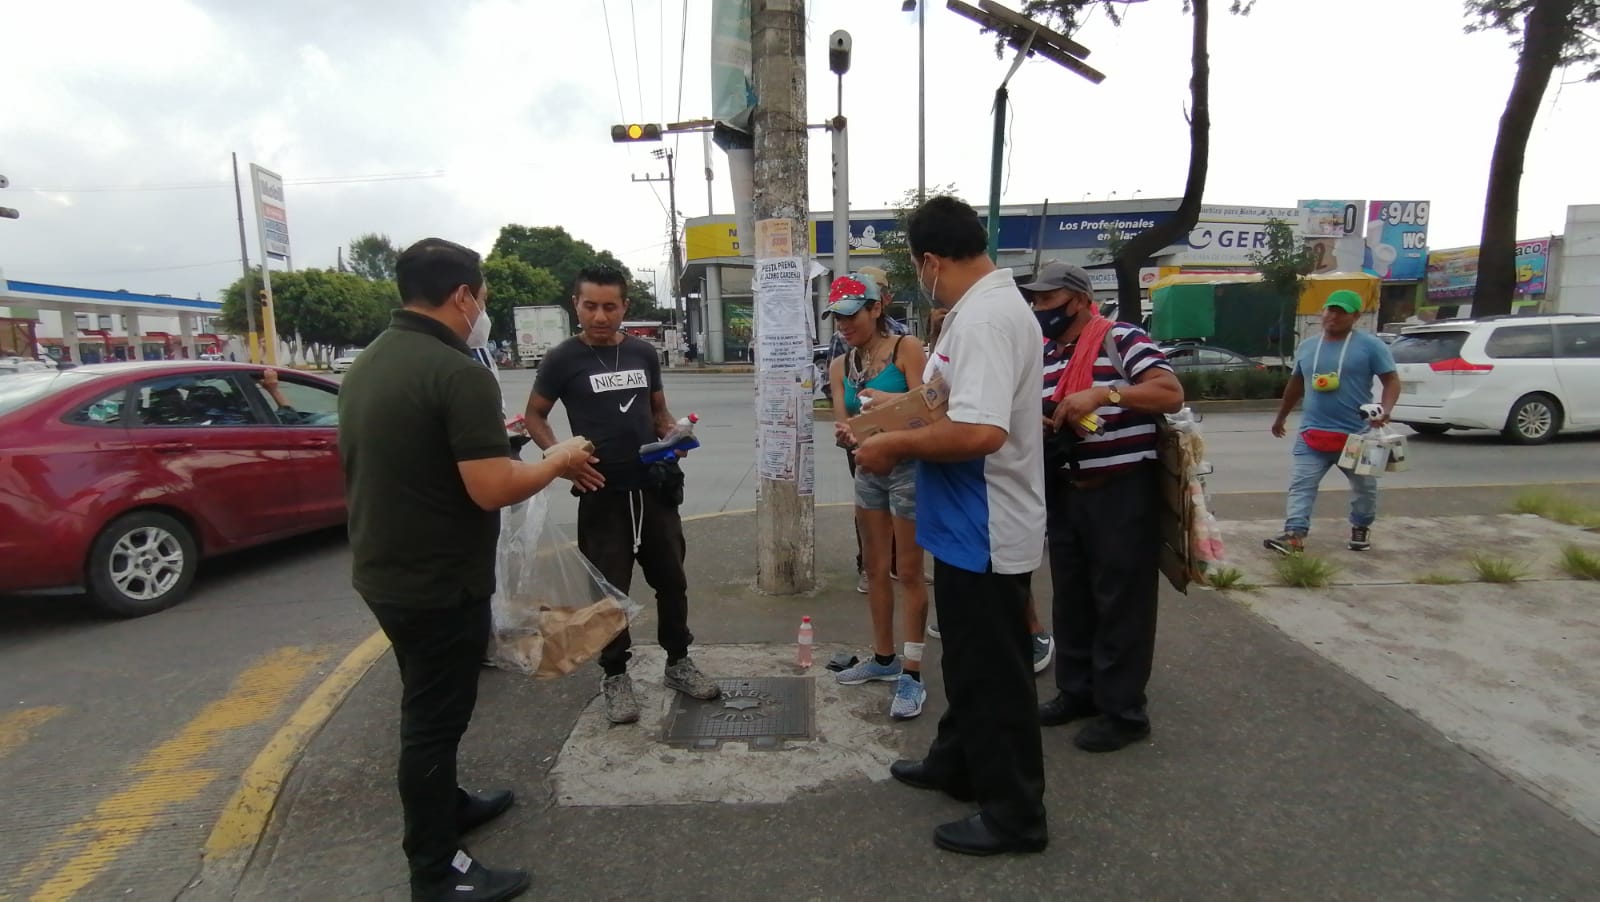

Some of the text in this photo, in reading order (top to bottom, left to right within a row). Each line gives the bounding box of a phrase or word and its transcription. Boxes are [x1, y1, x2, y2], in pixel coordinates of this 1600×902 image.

[1381, 202, 1428, 226] $949
[1059, 221, 1078, 231] Los
[1402, 231, 1425, 249] WC
[594, 373, 646, 389] NIKE AIR
